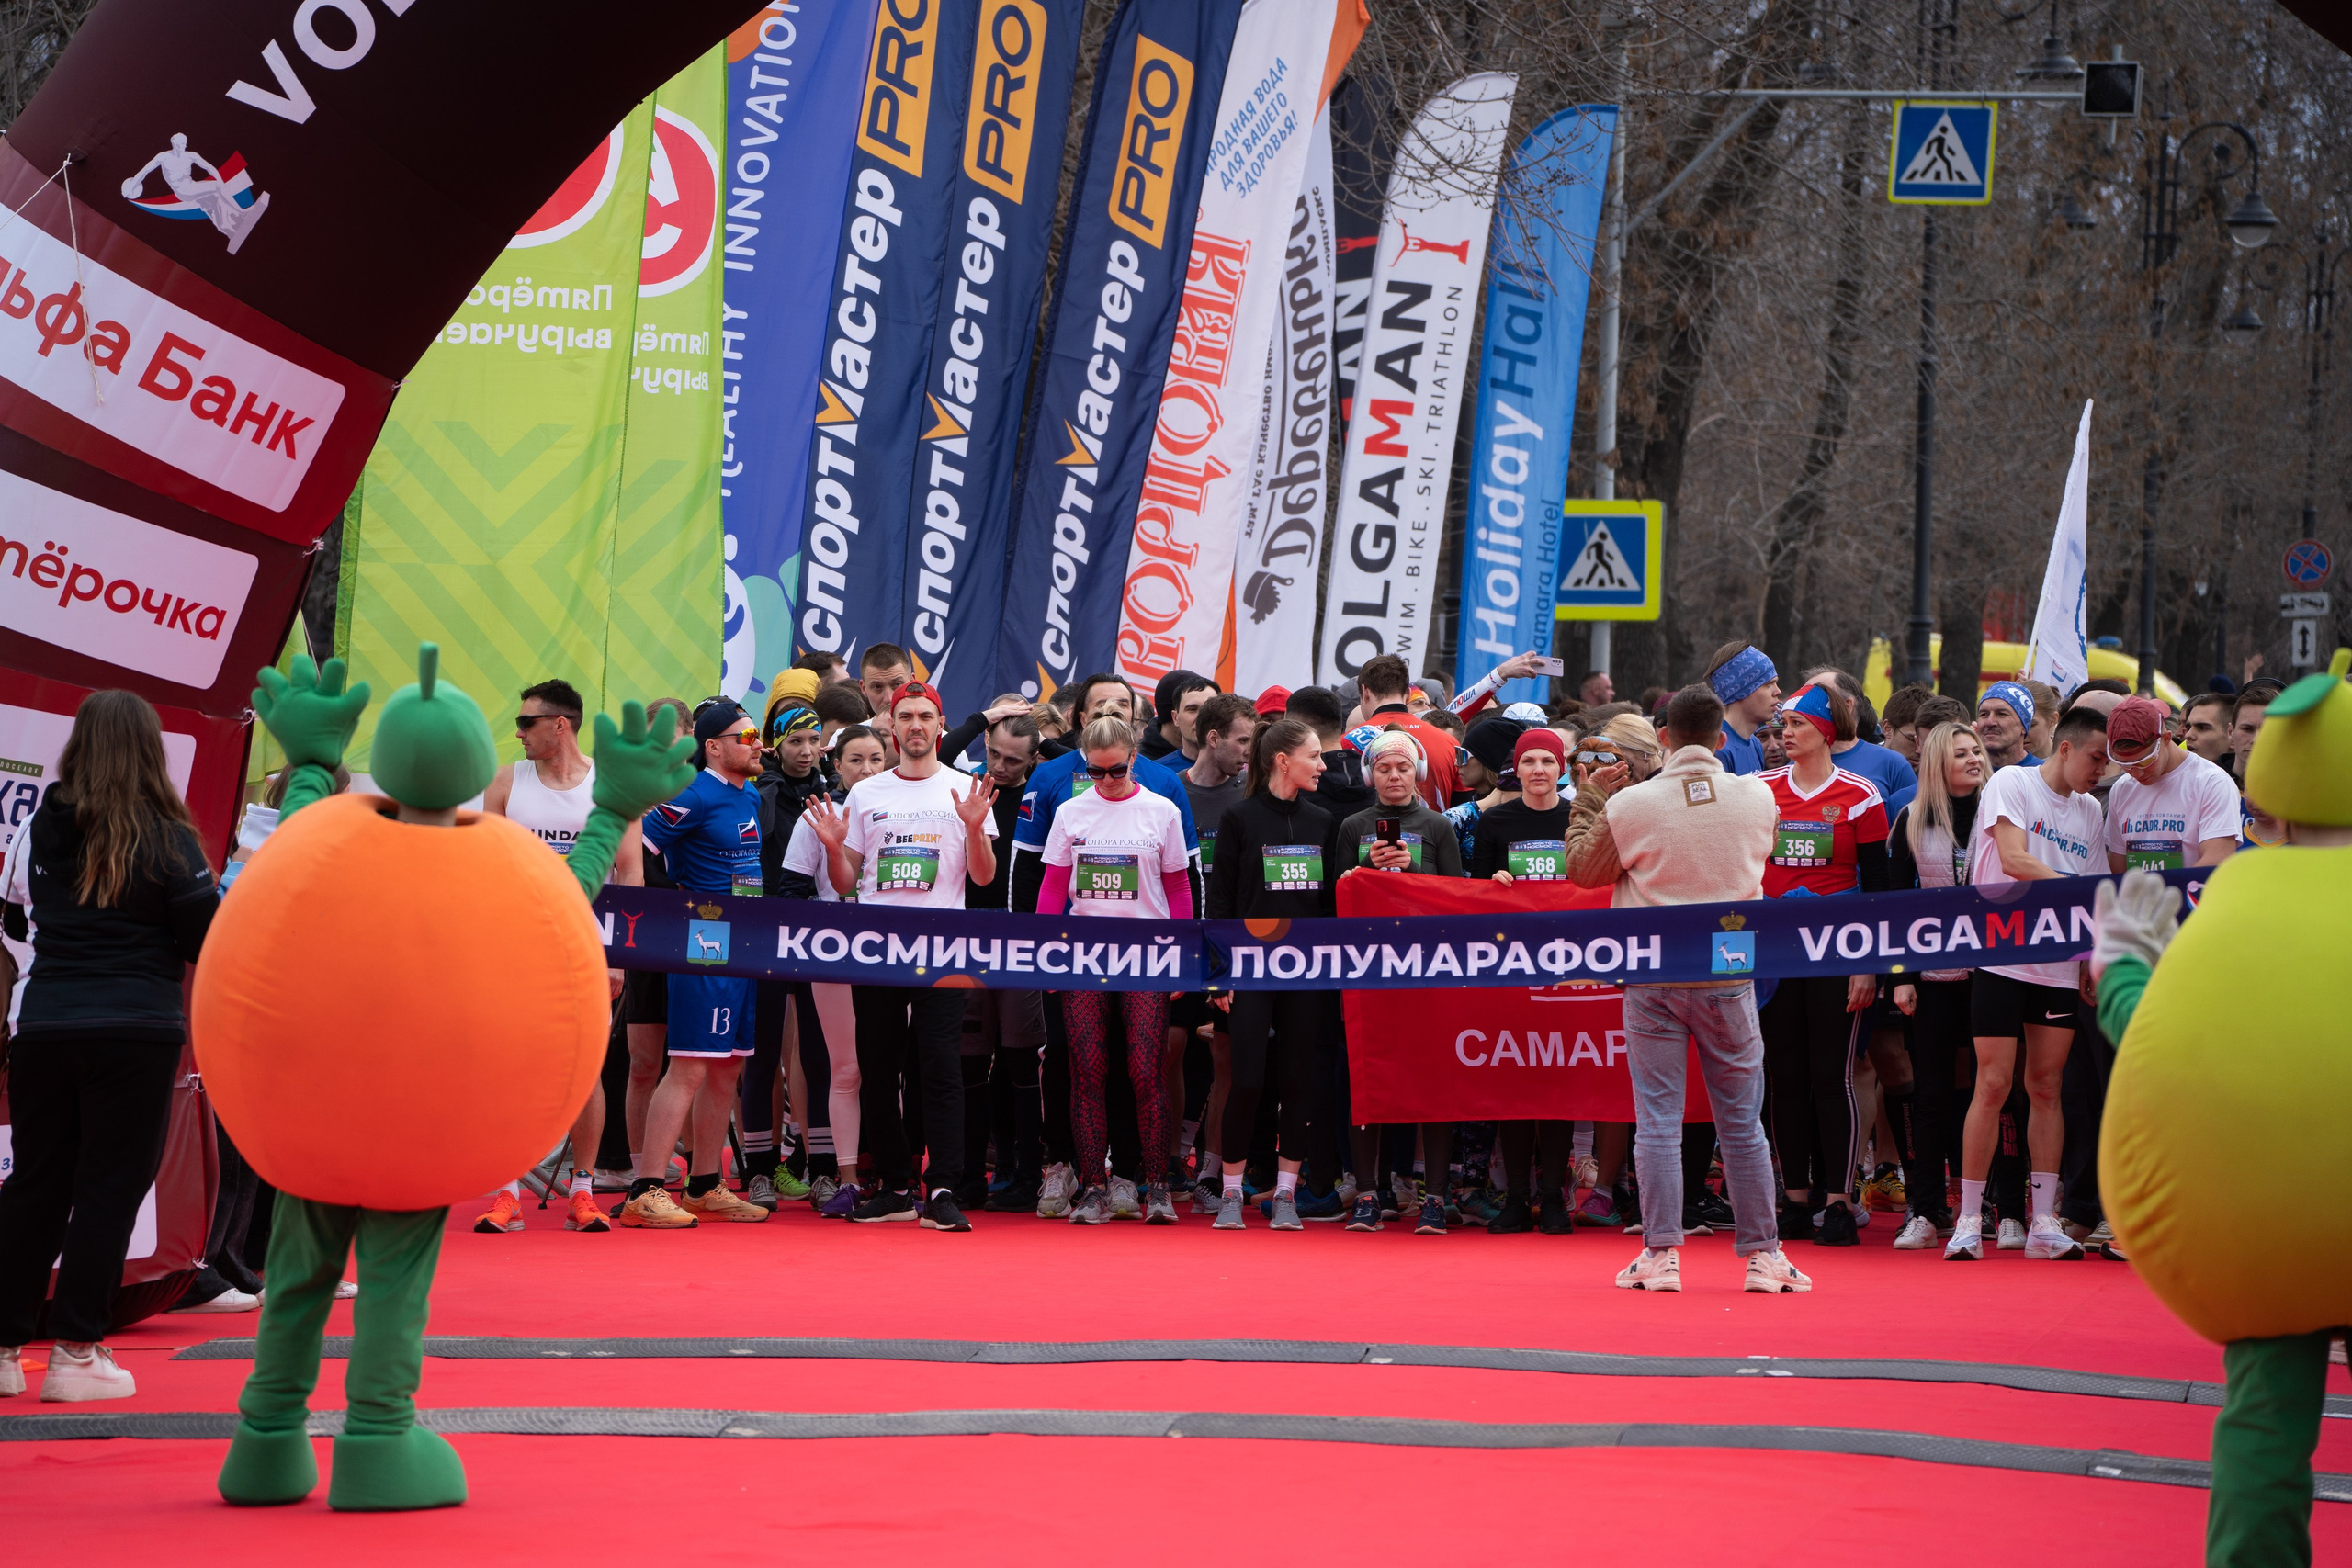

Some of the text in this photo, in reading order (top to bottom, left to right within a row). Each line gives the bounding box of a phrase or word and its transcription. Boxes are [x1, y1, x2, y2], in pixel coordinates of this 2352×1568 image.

[976, 4, 1033, 186] PRO
[1253, 57, 1288, 105] ВОДА
[724, 0, 800, 272] INNOVATIO
[1118, 58, 1180, 231] PRO
[1220, 91, 1288, 192] ДЛЯ ВАШЕГО
[1237, 109, 1299, 199] ЗДОРОВЬЯ!
[1426, 286, 1463, 434] TRIATHLON
[137, 331, 316, 460] Банк
[1332, 280, 1433, 686] OLGAMAN
[1416, 457, 1437, 497] SKI
[1475, 260, 1549, 658] Holiday Hall
[1406, 521, 1428, 577] BIKE
[1533, 499, 1560, 658] amara Hotel
[896, 833, 942, 844] BEEPRINT
[1526, 856, 1555, 874] 368
[1784, 839, 1815, 857] 356
[891, 863, 922, 879] 508
[1092, 873, 1121, 889] 509
[1281, 863, 1308, 880] 355
[777, 924, 1661, 979] КОСМИЧЕСКИЙ ПОЛУМАРАФОН
[708, 1007, 730, 1035] 13
[1454, 1028, 1629, 1067] САМАР
